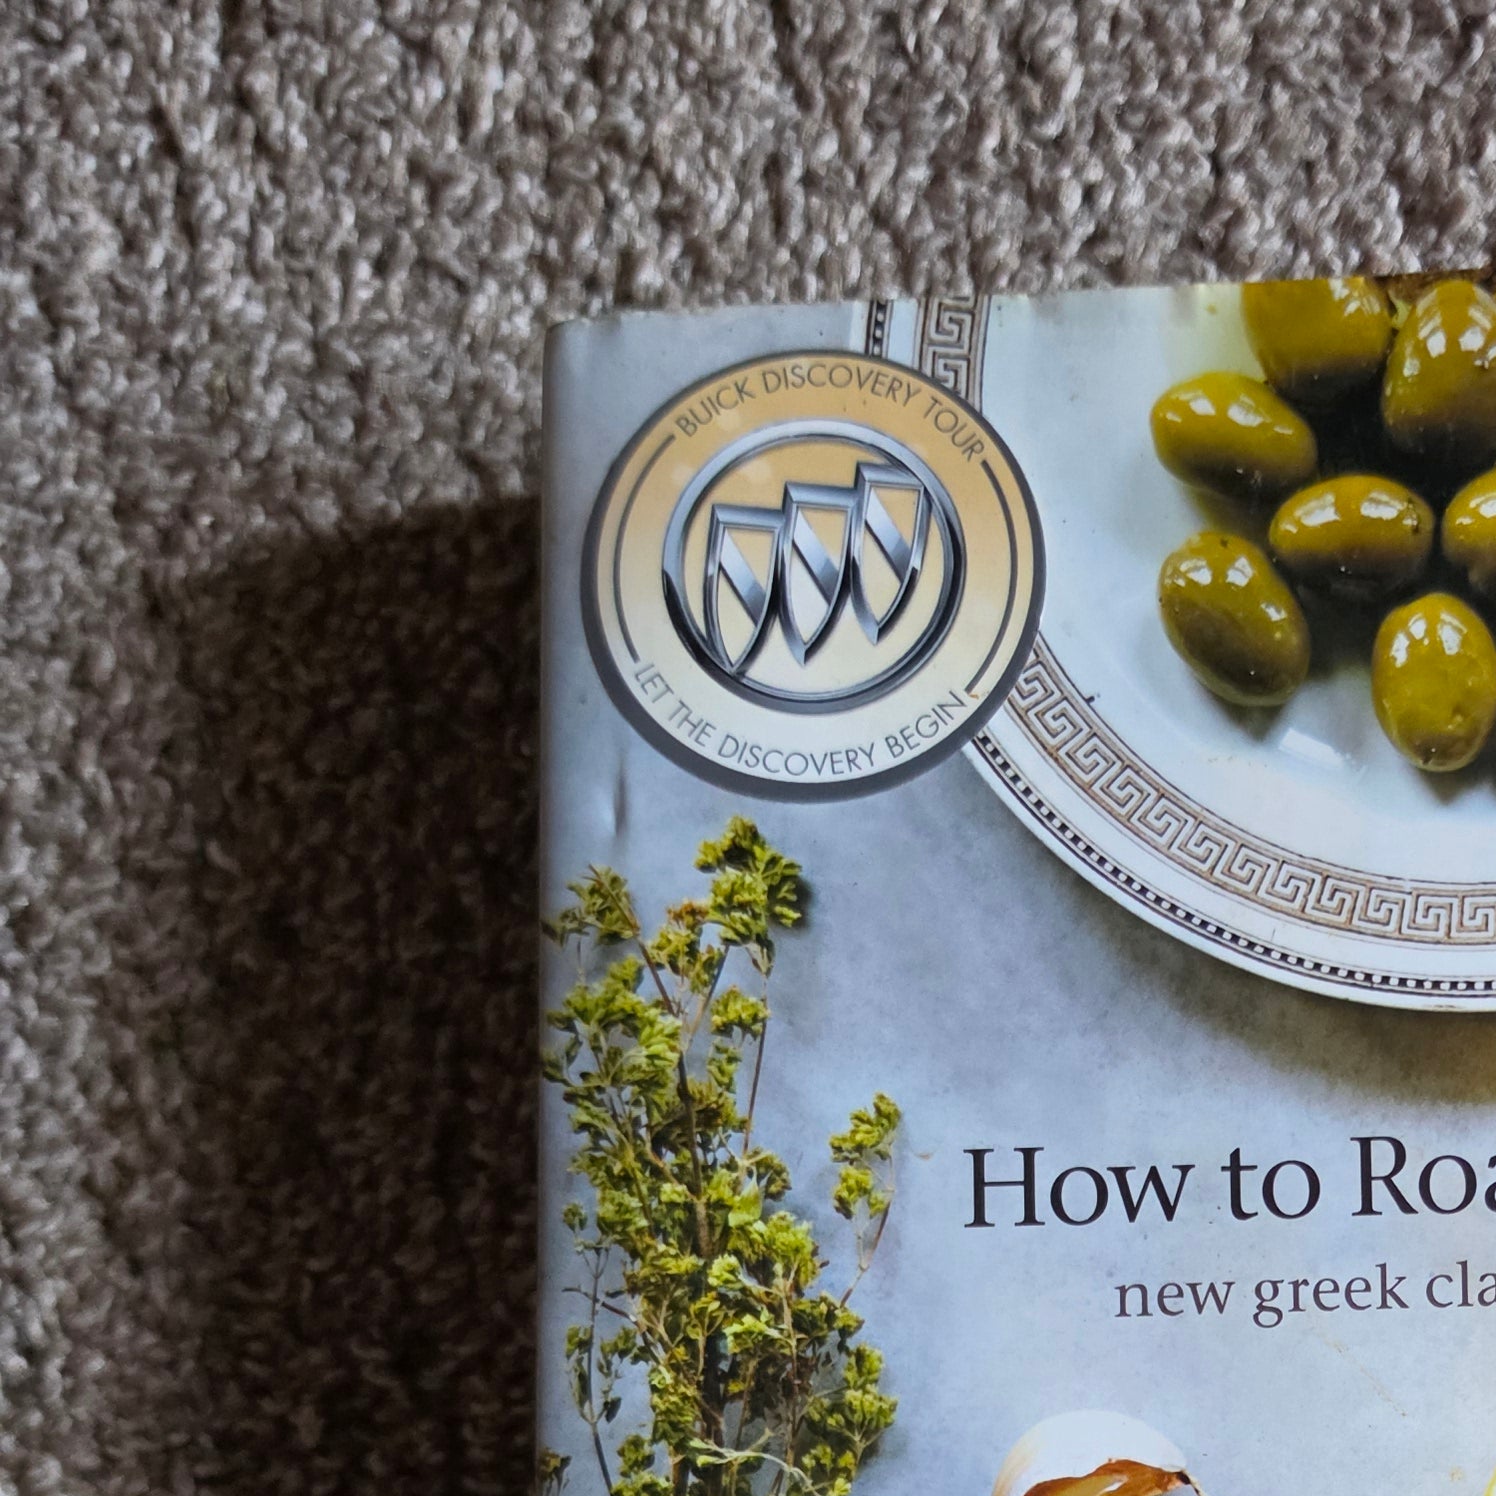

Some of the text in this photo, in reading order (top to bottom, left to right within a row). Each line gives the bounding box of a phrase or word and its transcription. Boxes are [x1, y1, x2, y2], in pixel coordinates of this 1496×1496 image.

[675, 363, 986, 461] BUICK DISCOVERY TOUR
[634, 662, 967, 776] LET THE DISCOVERY BEGIN
[963, 1146, 1194, 1229] How
[1220, 1148, 1322, 1220] to
[1114, 1272, 1235, 1318] new
[1254, 1262, 1408, 1329] greek
